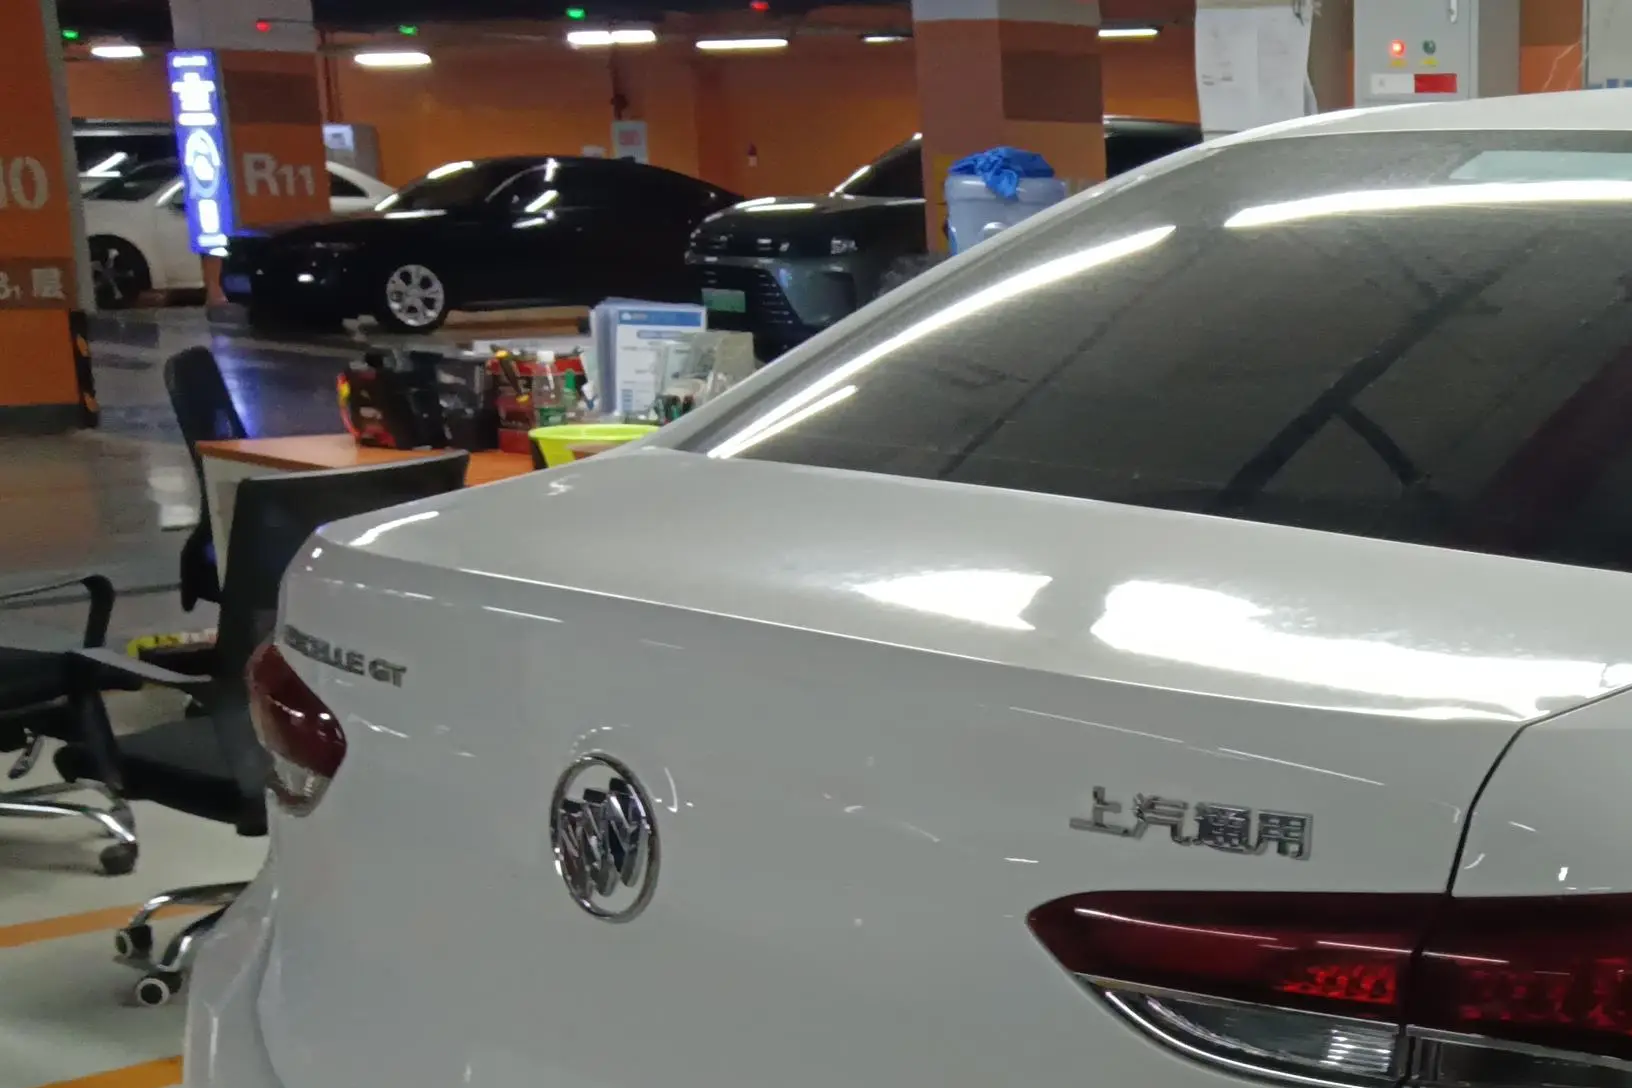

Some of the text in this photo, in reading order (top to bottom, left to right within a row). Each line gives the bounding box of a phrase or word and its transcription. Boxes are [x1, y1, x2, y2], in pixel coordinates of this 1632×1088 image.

[242, 153, 315, 196] R11
[369, 658, 407, 688] GT
[1069, 786, 1314, 861] 上汽通用
